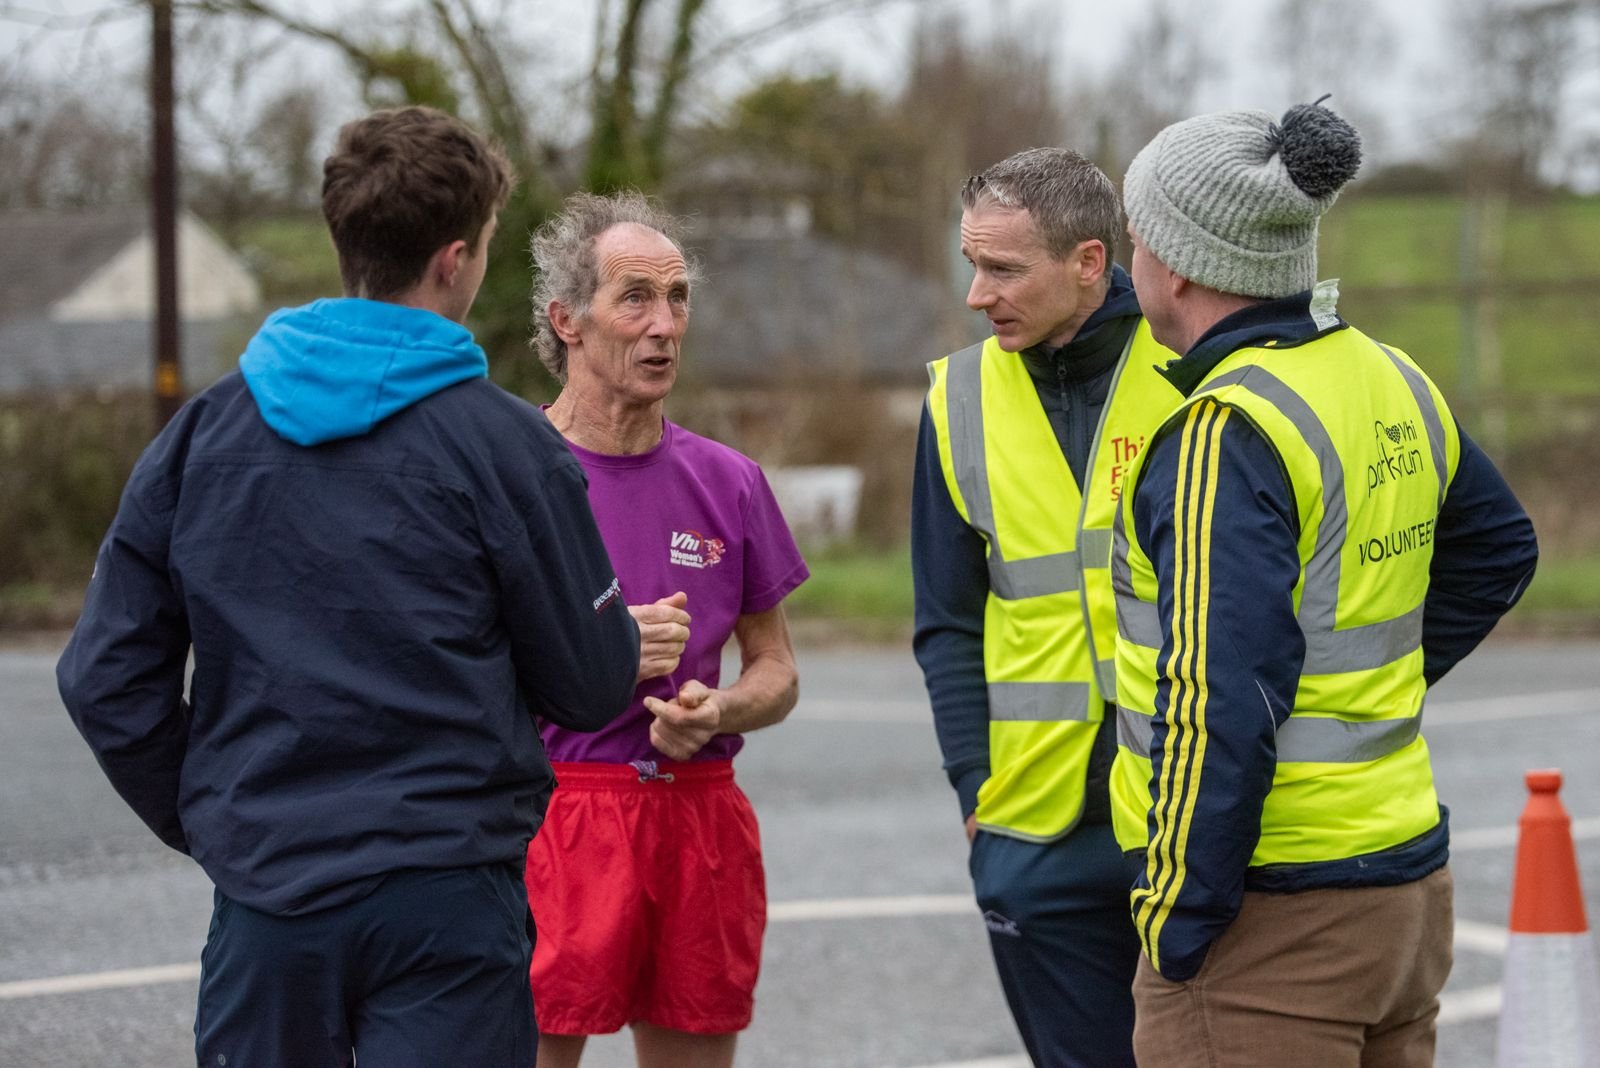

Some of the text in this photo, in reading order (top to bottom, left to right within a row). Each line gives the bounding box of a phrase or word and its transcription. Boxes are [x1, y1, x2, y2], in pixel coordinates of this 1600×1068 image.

[1111, 436, 1145, 463] Thi
[1368, 442, 1424, 499] parkrun
[671, 531, 700, 551] Vhi
